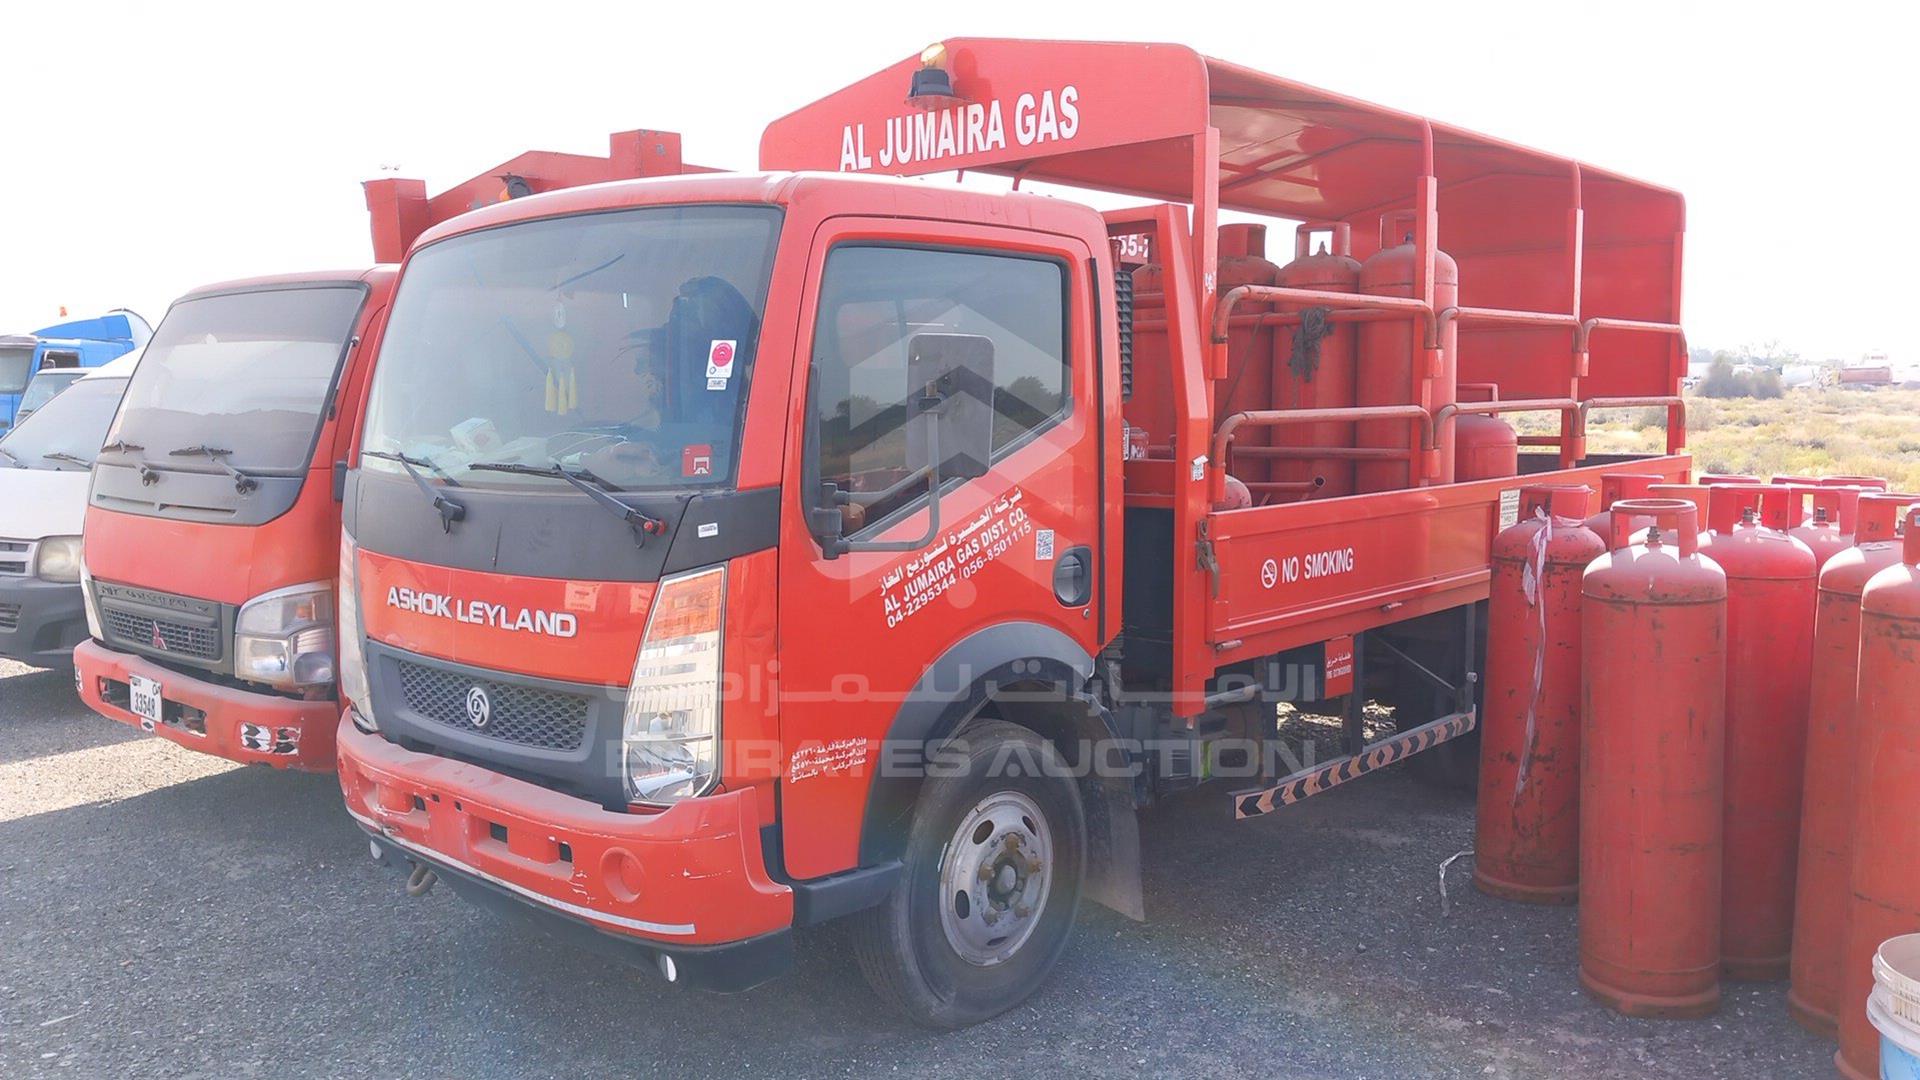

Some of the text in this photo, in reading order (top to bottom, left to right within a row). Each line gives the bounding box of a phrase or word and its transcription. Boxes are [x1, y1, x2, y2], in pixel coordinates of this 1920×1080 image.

[839, 84, 1080, 172] AL JUMAIRA GAS
[994, 485, 1024, 514] شركة
[879, 565, 904, 597] الغاز
[884, 507, 1028, 615] AL JUMAIRA GAS DIST. CO.
[905, 536, 949, 580] لتوزيع
[1281, 547, 1355, 584] NO SMOKING
[387, 586, 578, 639] ASHOK LEYLAND
[886, 573, 957, 629] 04-2295344
